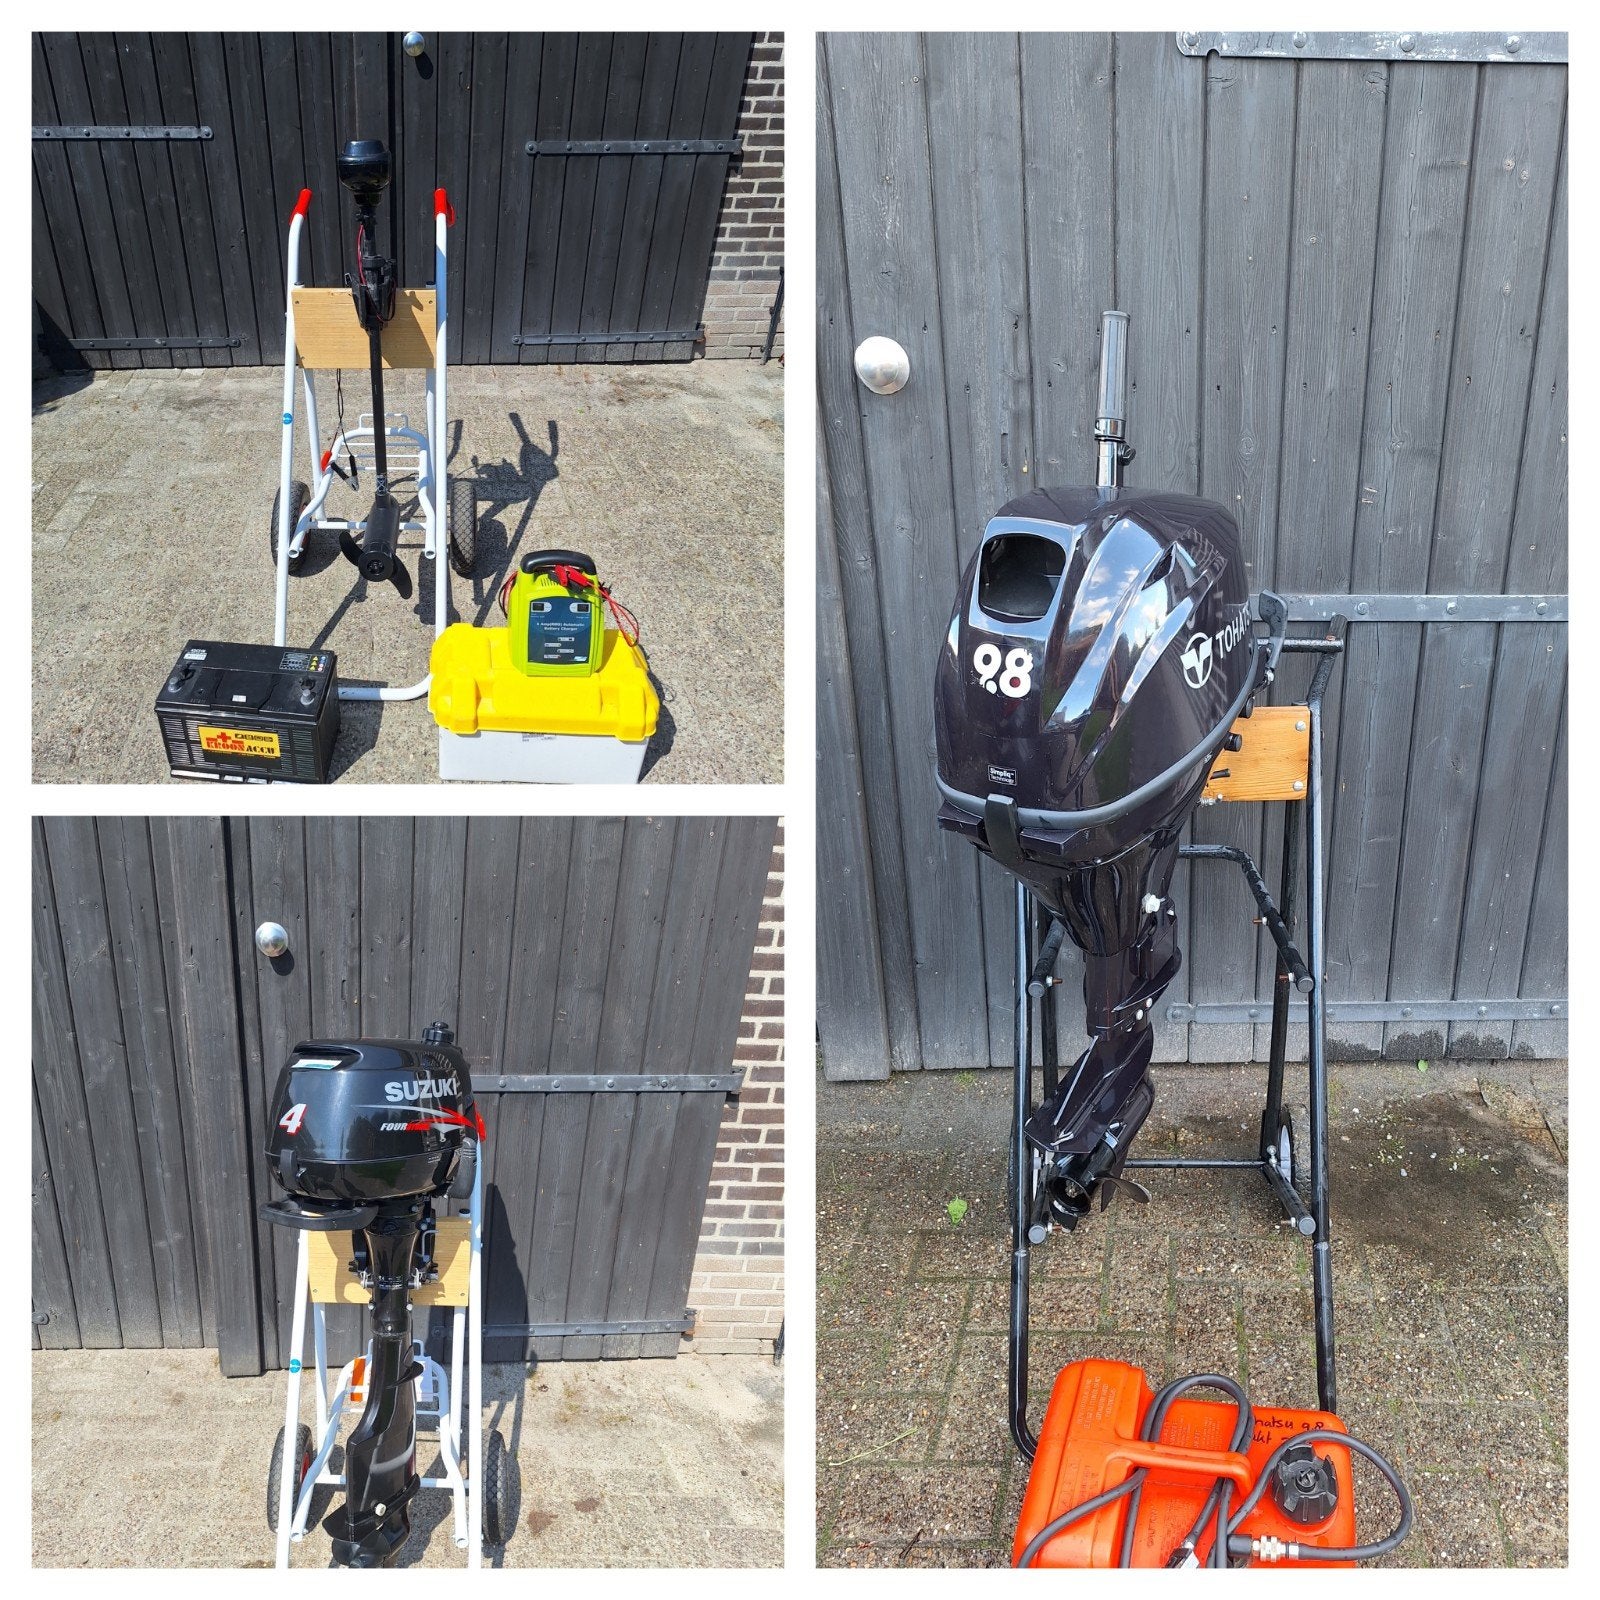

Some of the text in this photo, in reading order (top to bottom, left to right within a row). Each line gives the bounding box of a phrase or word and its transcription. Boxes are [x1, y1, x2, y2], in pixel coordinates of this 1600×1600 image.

[246, 745, 275, 755] ACCU
[384, 1078, 458, 1102] SUZUKI
[279, 1103, 307, 1135] 4
